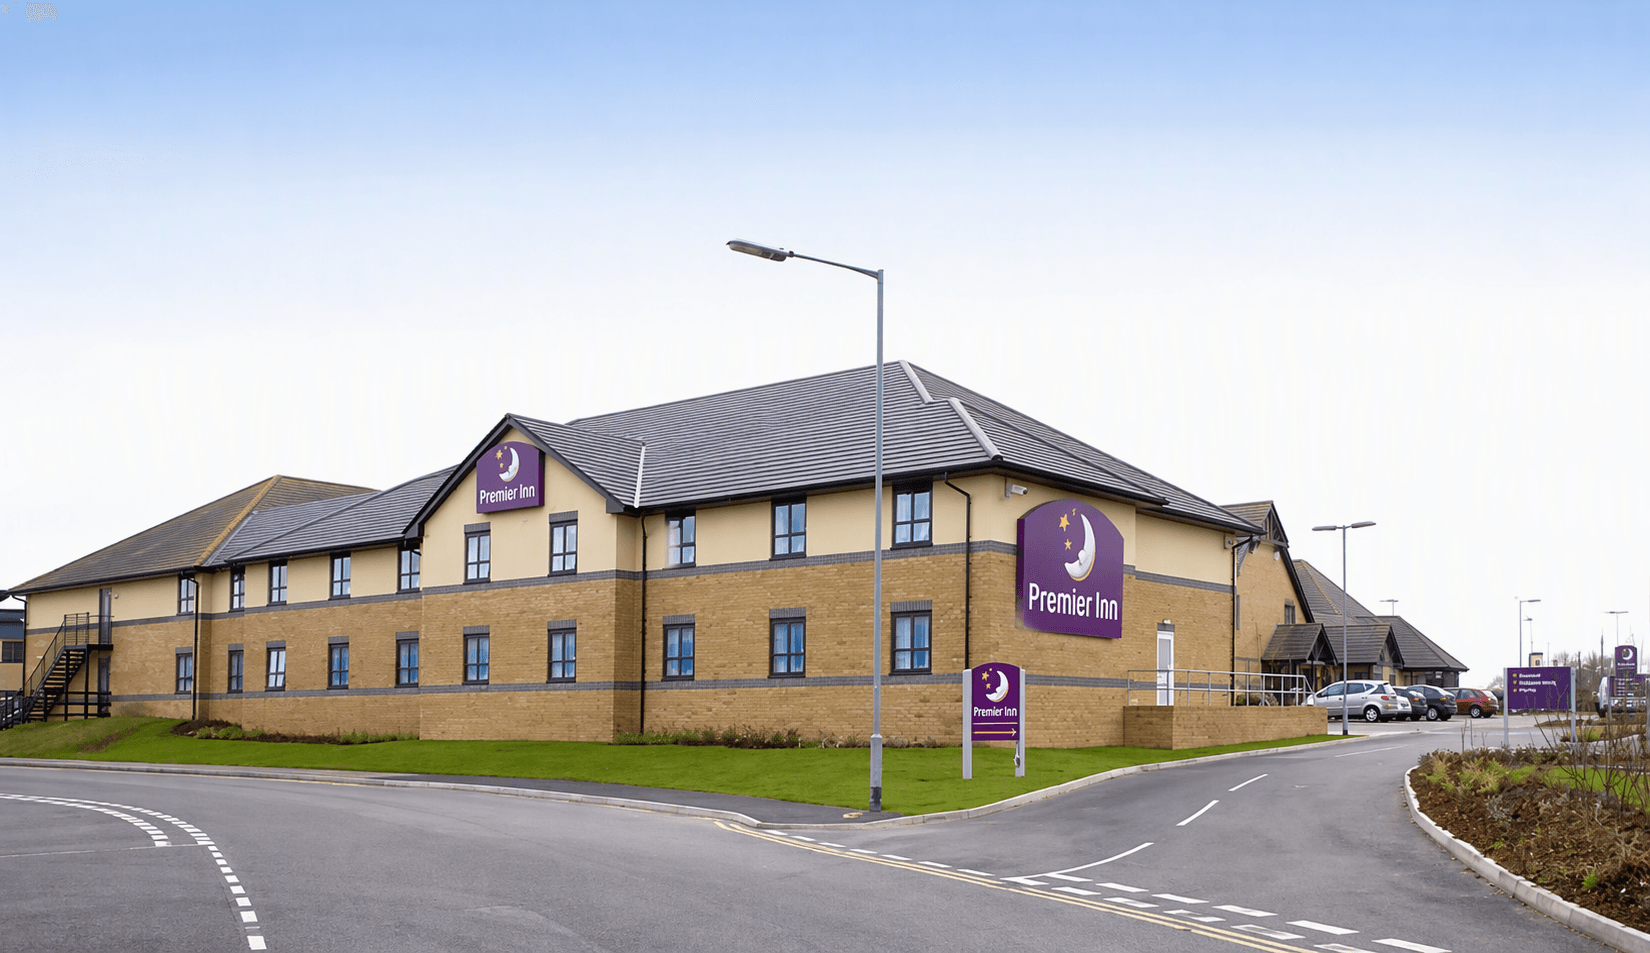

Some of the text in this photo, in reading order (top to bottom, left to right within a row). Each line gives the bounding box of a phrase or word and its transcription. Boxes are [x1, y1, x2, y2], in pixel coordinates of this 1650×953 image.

[480, 484, 535, 504] Premier Inn
[1028, 582, 1118, 620] Premier Inn
[973, 706, 1018, 717] Premier Inn
